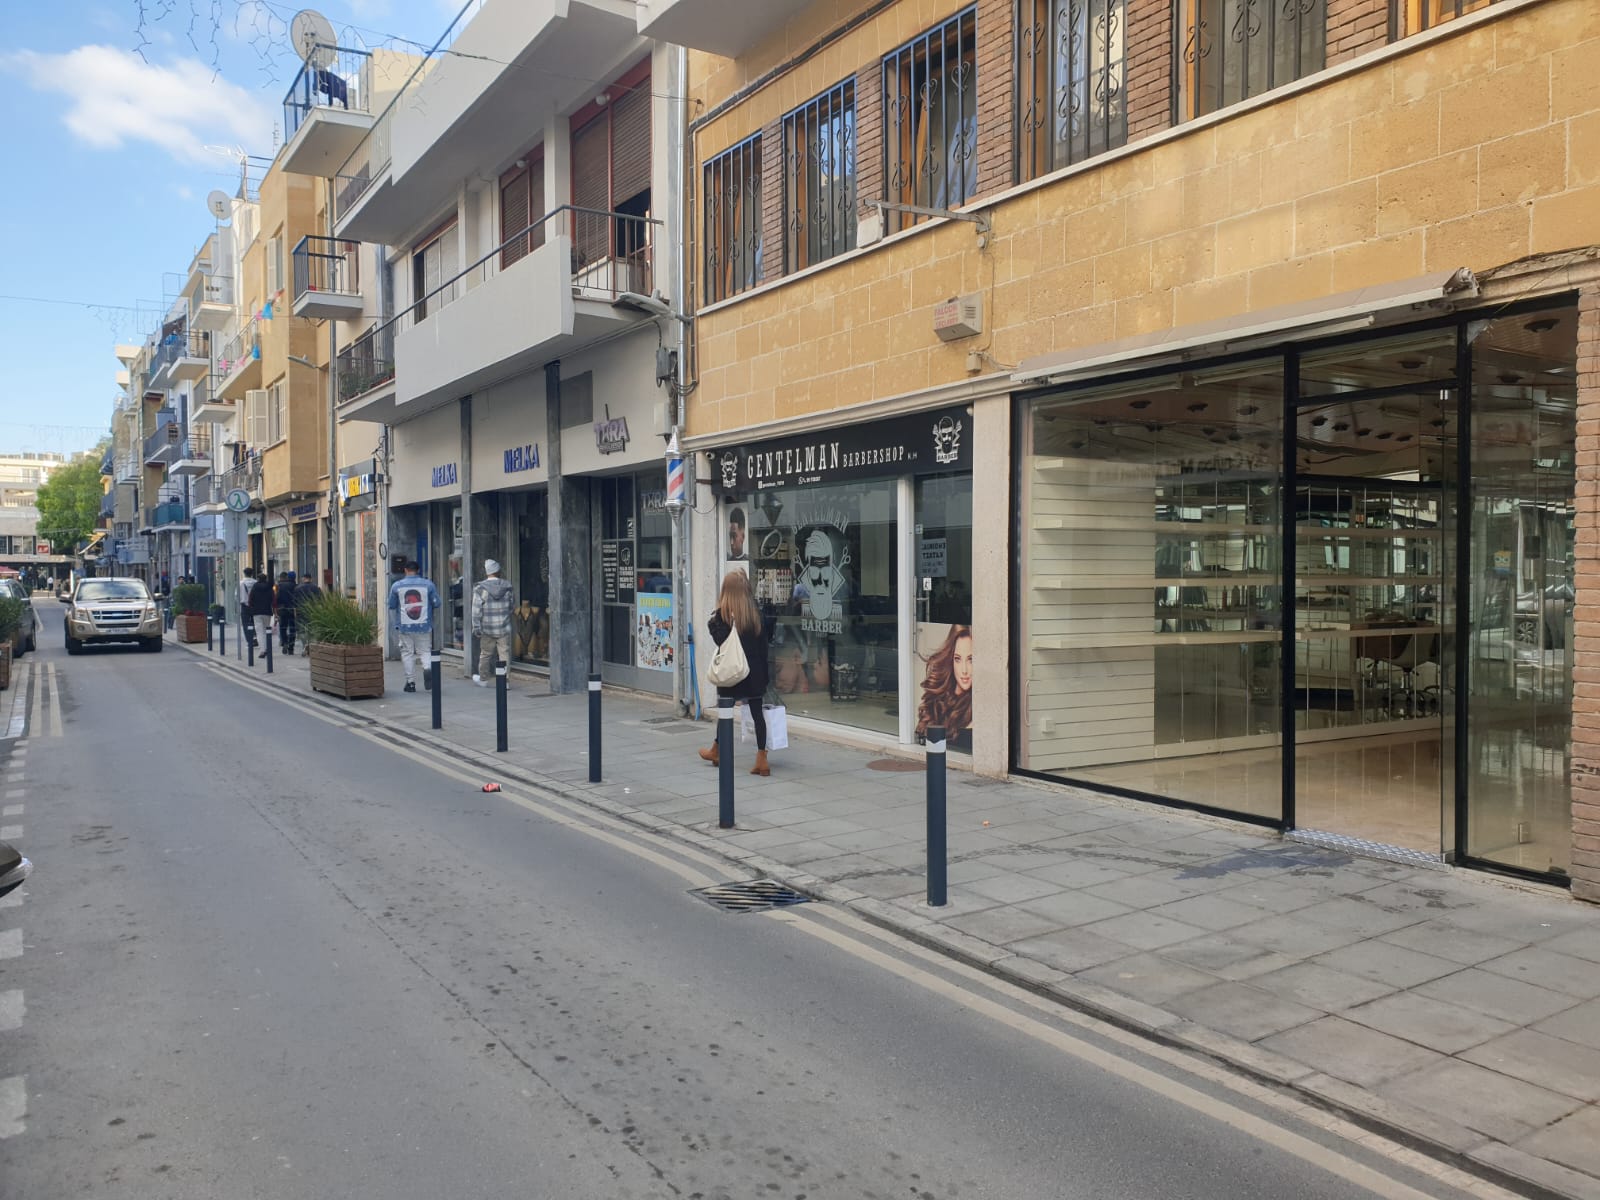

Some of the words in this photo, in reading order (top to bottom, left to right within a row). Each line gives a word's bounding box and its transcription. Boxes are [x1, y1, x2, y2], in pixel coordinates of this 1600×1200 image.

[504, 443, 539, 473] MELKA
[748, 442, 839, 479] GENTELMAN
[843, 446, 904, 468] BARBERSHOP
[432, 463, 457, 487] MELKA
[801, 619, 842, 634] BARBER
